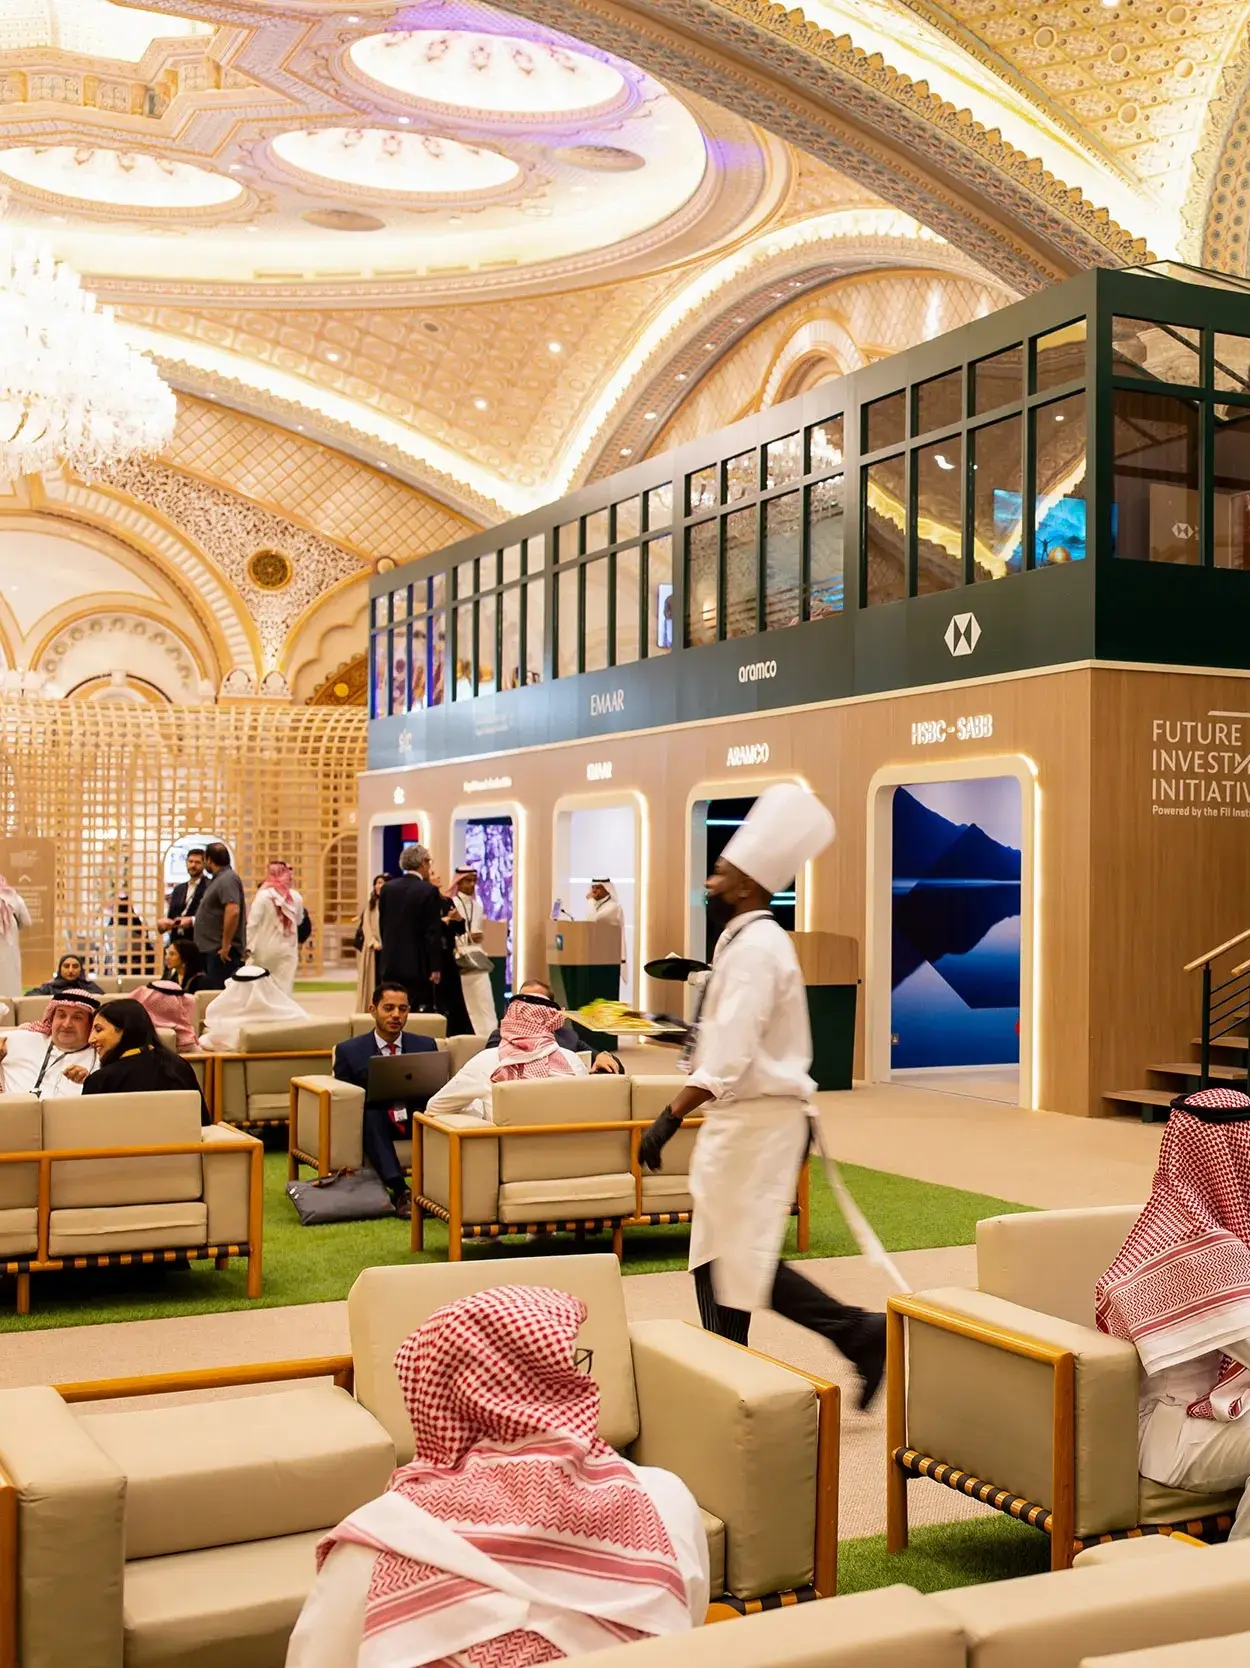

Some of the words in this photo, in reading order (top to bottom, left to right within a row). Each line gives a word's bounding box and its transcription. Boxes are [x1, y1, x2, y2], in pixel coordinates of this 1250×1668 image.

[738, 659, 778, 684] aramco
[590, 688, 625, 717] EMAAR
[911, 719, 947, 746] HSBC
[956, 713, 993, 741] SABB
[1152, 719, 1242, 746] FUTURE
[726, 742, 770, 767] ARAMCO
[1152, 804, 1189, 816] Powered
[1191, 806, 1201, 818] by
[1203, 807, 1218, 817] the
[1220, 807, 1231, 817] FII
